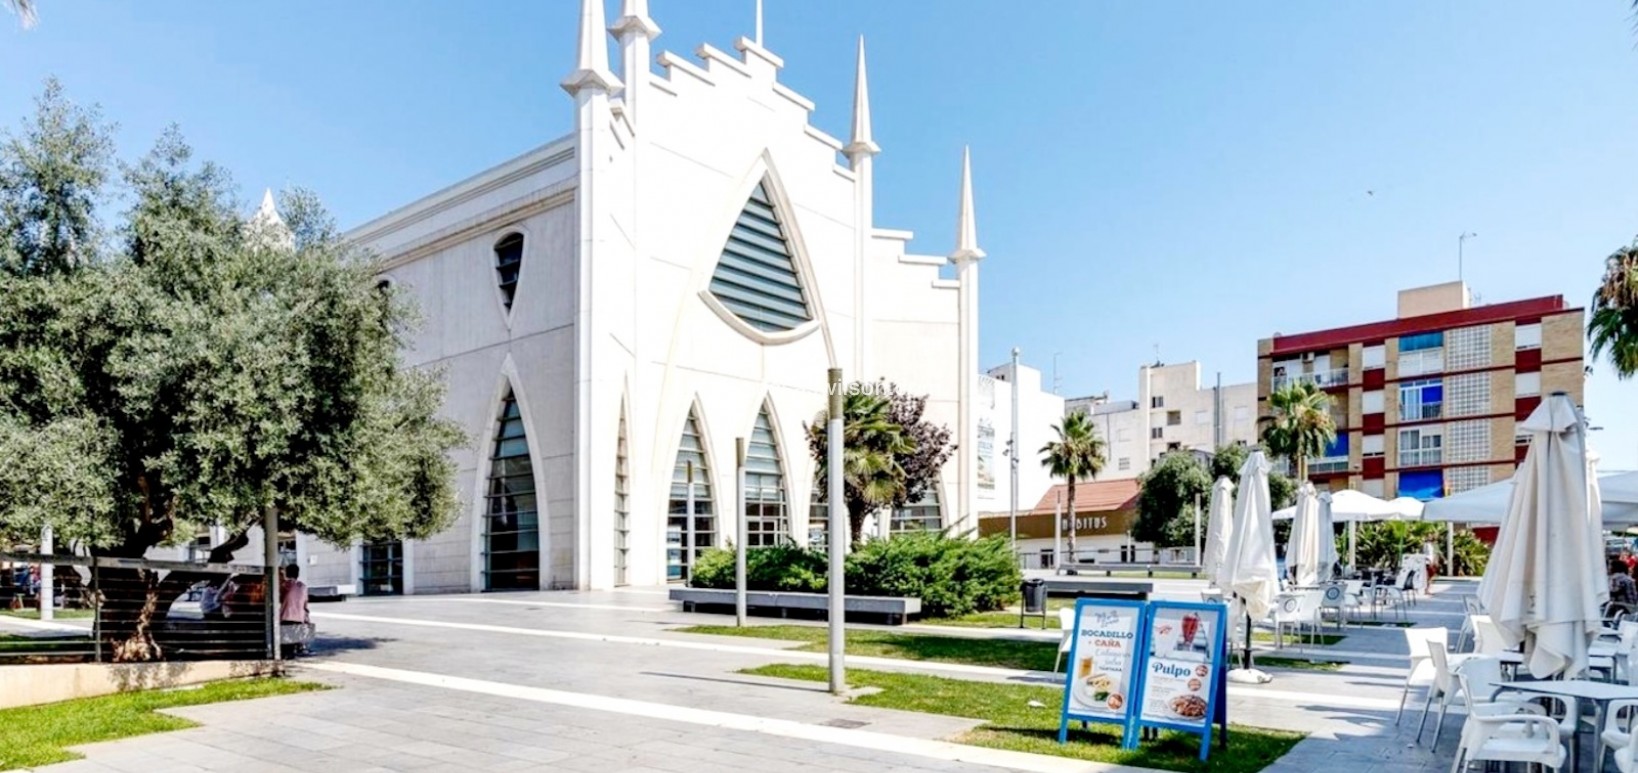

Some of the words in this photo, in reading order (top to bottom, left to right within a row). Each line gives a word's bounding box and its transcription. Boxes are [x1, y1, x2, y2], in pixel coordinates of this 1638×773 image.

[1081, 629, 1134, 639] BOCADILLO
[1094, 638, 1121, 648] CAÑA
[1152, 662, 1191, 678] Pulpo
